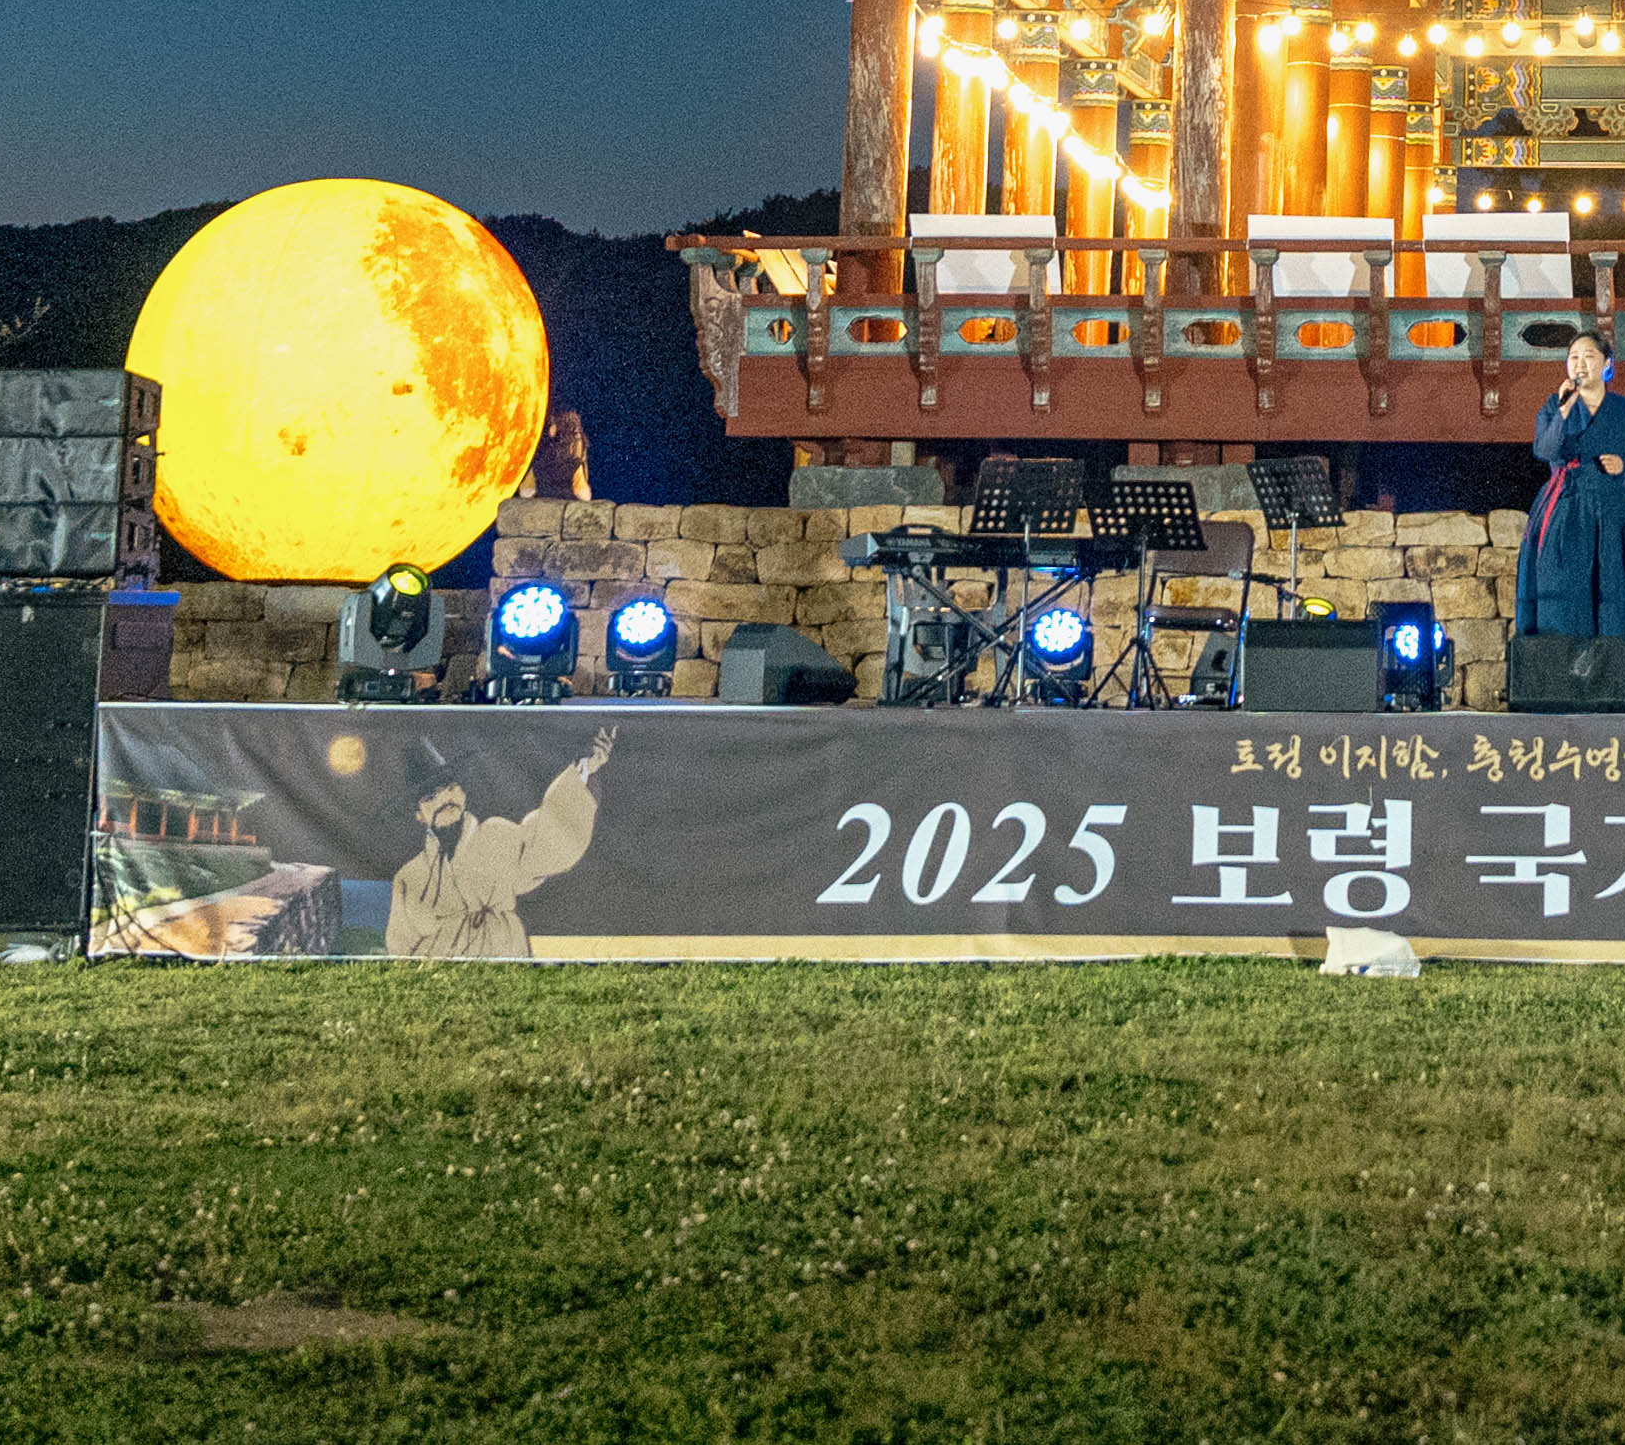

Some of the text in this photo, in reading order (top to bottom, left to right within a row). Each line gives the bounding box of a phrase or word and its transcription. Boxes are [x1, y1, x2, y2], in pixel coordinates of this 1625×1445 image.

[1230, 733, 1303, 780] 토정
[1319, 733, 1449, 781] 이지함,
[815, 801, 1129, 906] 2025
[1170, 798, 1413, 918] 보령
